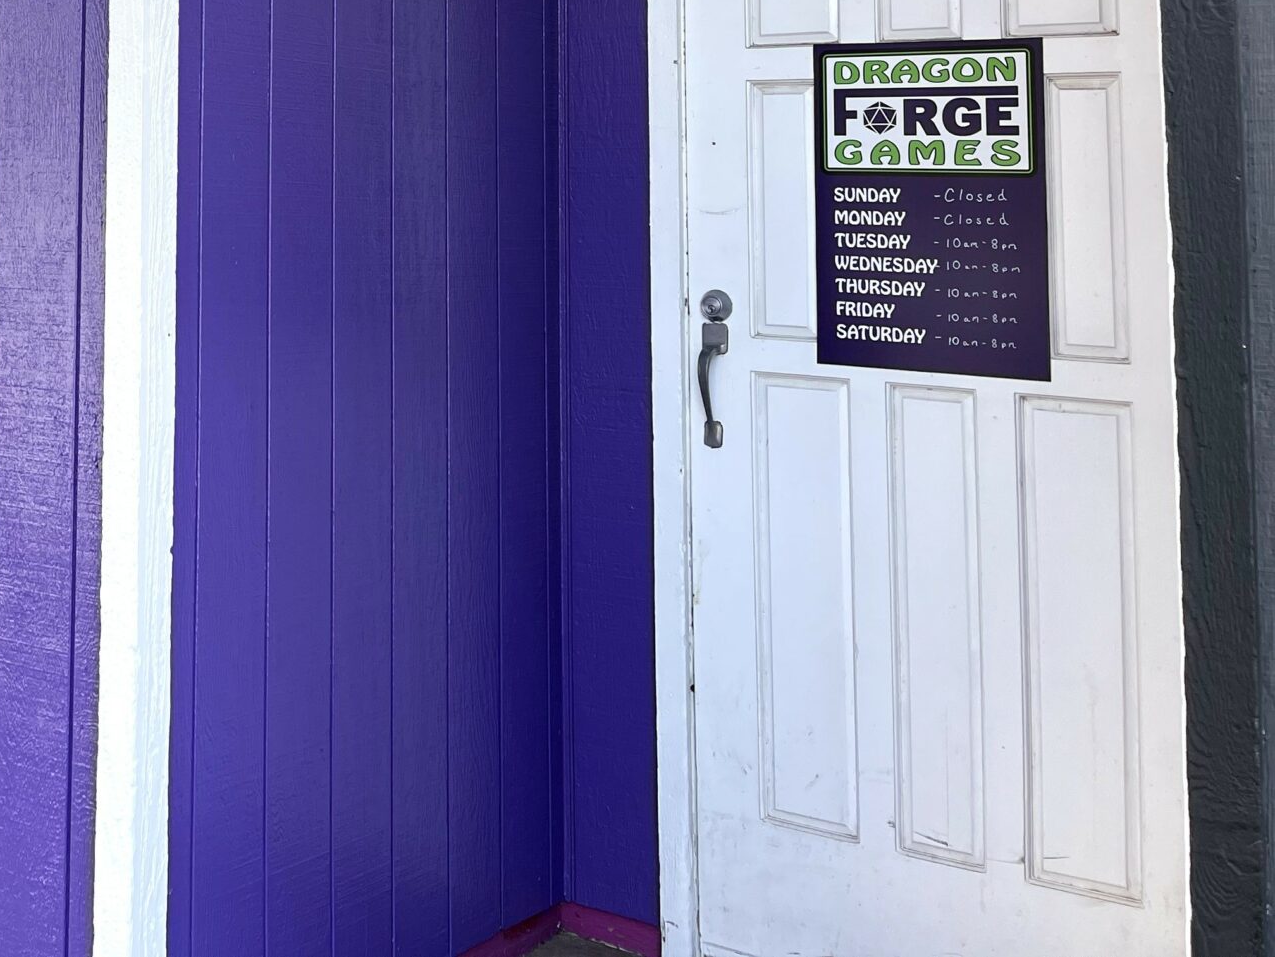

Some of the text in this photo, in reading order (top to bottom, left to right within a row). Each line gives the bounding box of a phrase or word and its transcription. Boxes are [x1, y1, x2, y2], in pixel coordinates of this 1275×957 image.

[833, 56, 1017, 86] DRAGON
[834, 138, 1022, 167] GAMES
[833, 186, 902, 203] SUNDAY
[833, 209, 907, 227] MONDAY
[834, 232, 912, 250] TUESDAY
[834, 254, 939, 275] WEDNESDAY
[834, 277, 926, 298] THURSDAY
[836, 300, 896, 319] FRIDAY
[836, 323, 927, 345] SATURDAY
